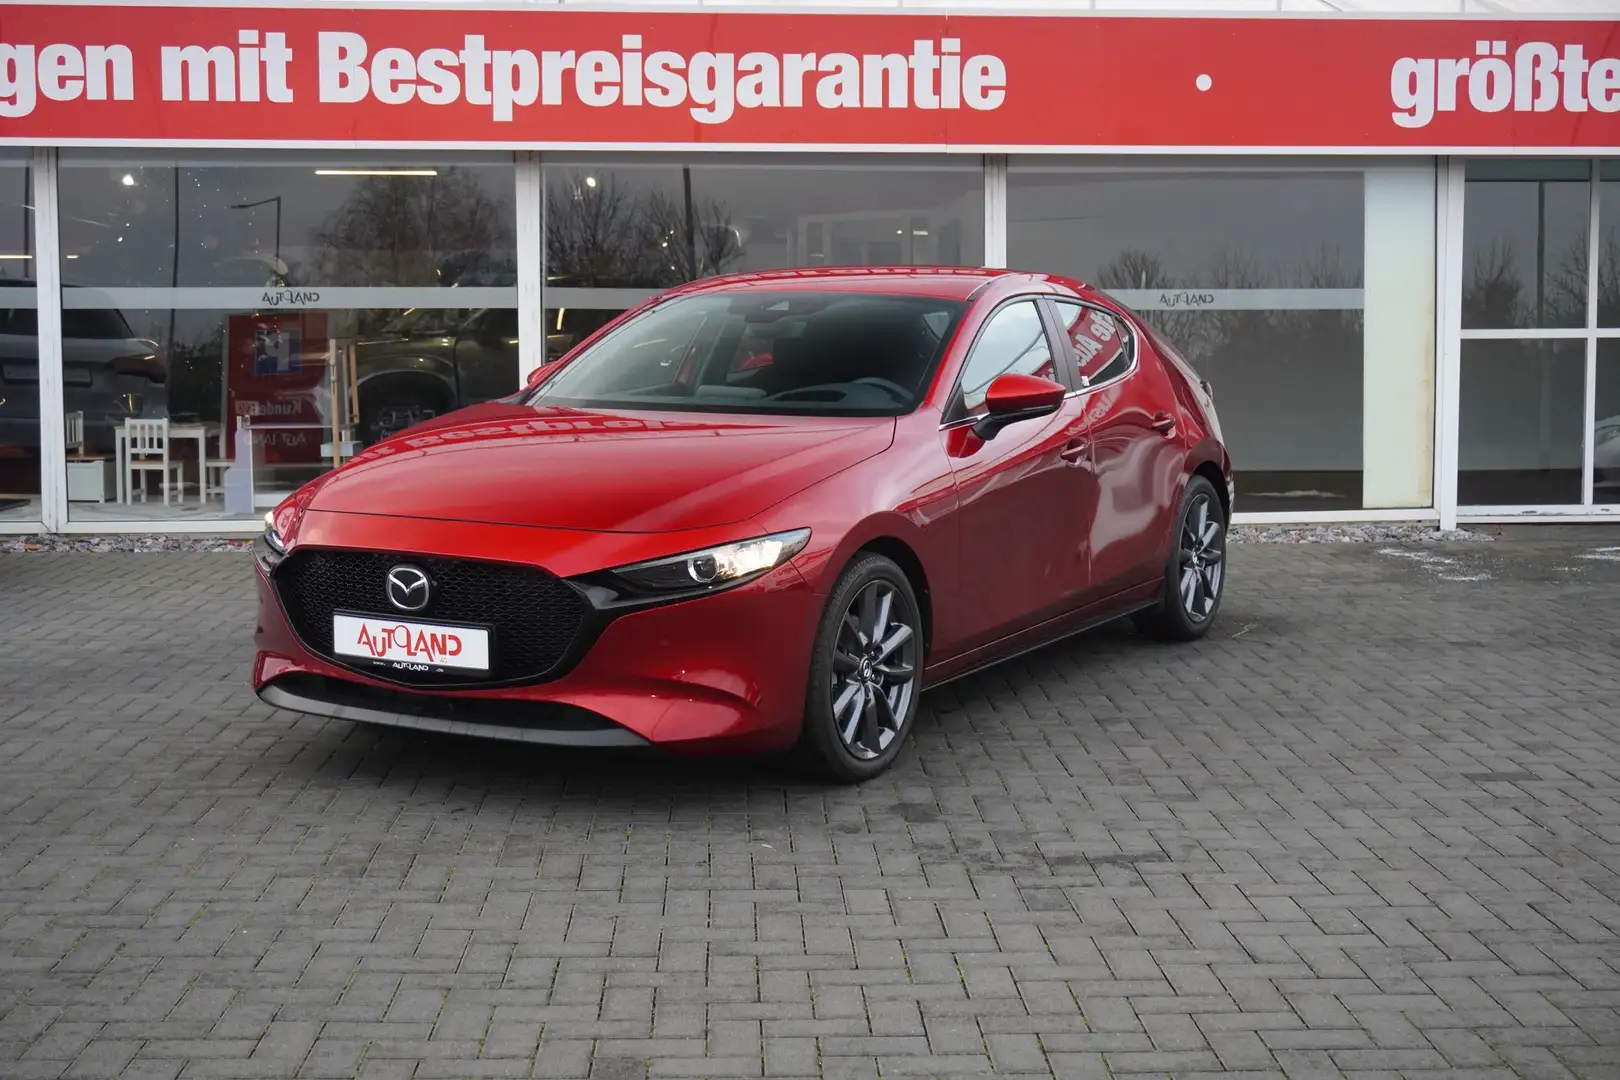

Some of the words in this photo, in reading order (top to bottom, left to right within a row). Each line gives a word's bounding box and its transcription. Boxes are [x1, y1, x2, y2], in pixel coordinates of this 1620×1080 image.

[0, 43, 134, 118] gen
[161, 29, 293, 103] mit
[317, 31, 1007, 124] Bestpreisgarantie
[1391, 40, 1620, 128] größte
[357, 623, 463, 662] AUTOLAND
